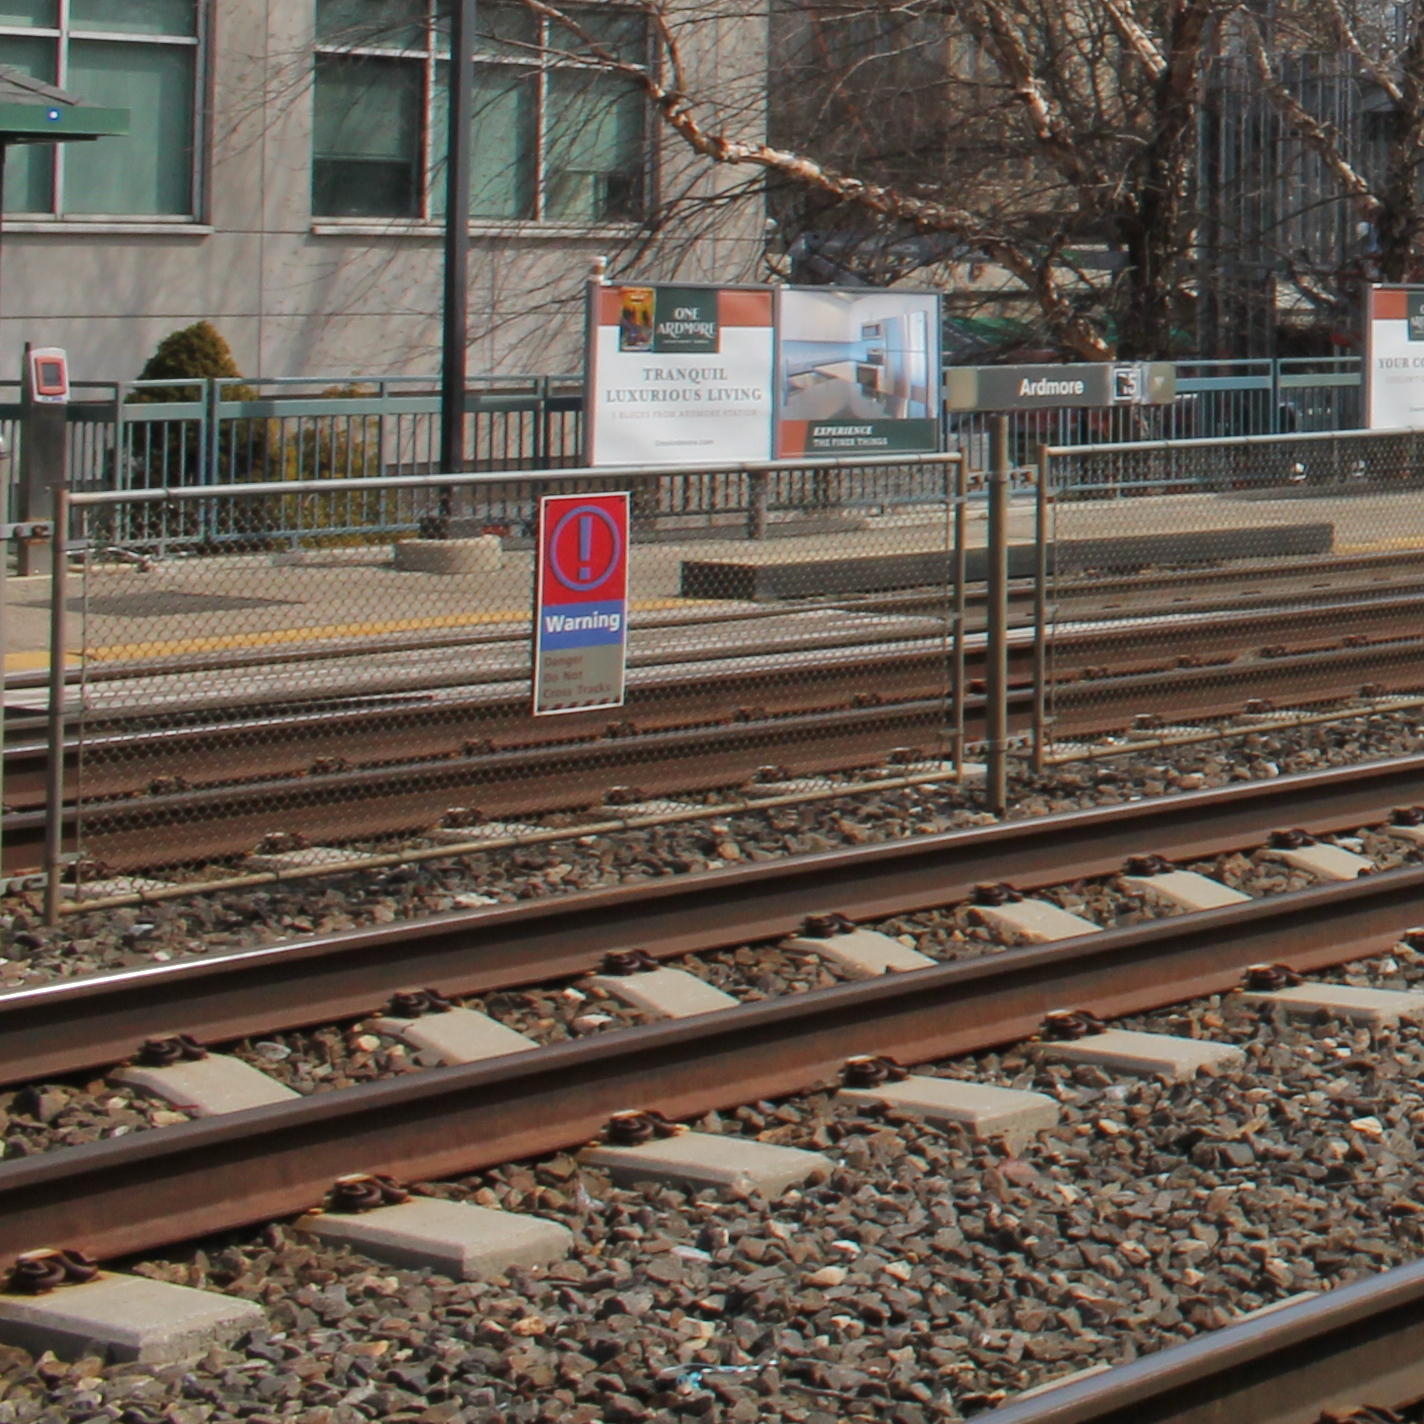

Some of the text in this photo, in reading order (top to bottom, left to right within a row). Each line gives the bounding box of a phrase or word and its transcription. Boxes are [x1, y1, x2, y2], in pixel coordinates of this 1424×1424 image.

[674, 307, 701, 320] ONE
[656, 321, 716, 339] ARDMORE
[1378, 357, 1409, 369] YOUR
[643, 368, 728, 384] TRANQUIL
[1019, 377, 1084, 397] Ardmore
[606, 388, 763, 403] LUXURIOUS LIVING
[619, 410, 650, 419] BLOCKS
[652, 410, 675, 418] FROM
[678, 409, 720, 418] ARDMORE
[722, 408, 757, 417] STATION
[813, 425, 873, 437] EXPERIENCE
[813, 438, 831, 447] THE
[545, 611, 620, 633] Warning
[544, 656, 583, 668] Danger
[544, 671, 582, 683] Do Not
[544, 683, 611, 698] Cross Tracks
